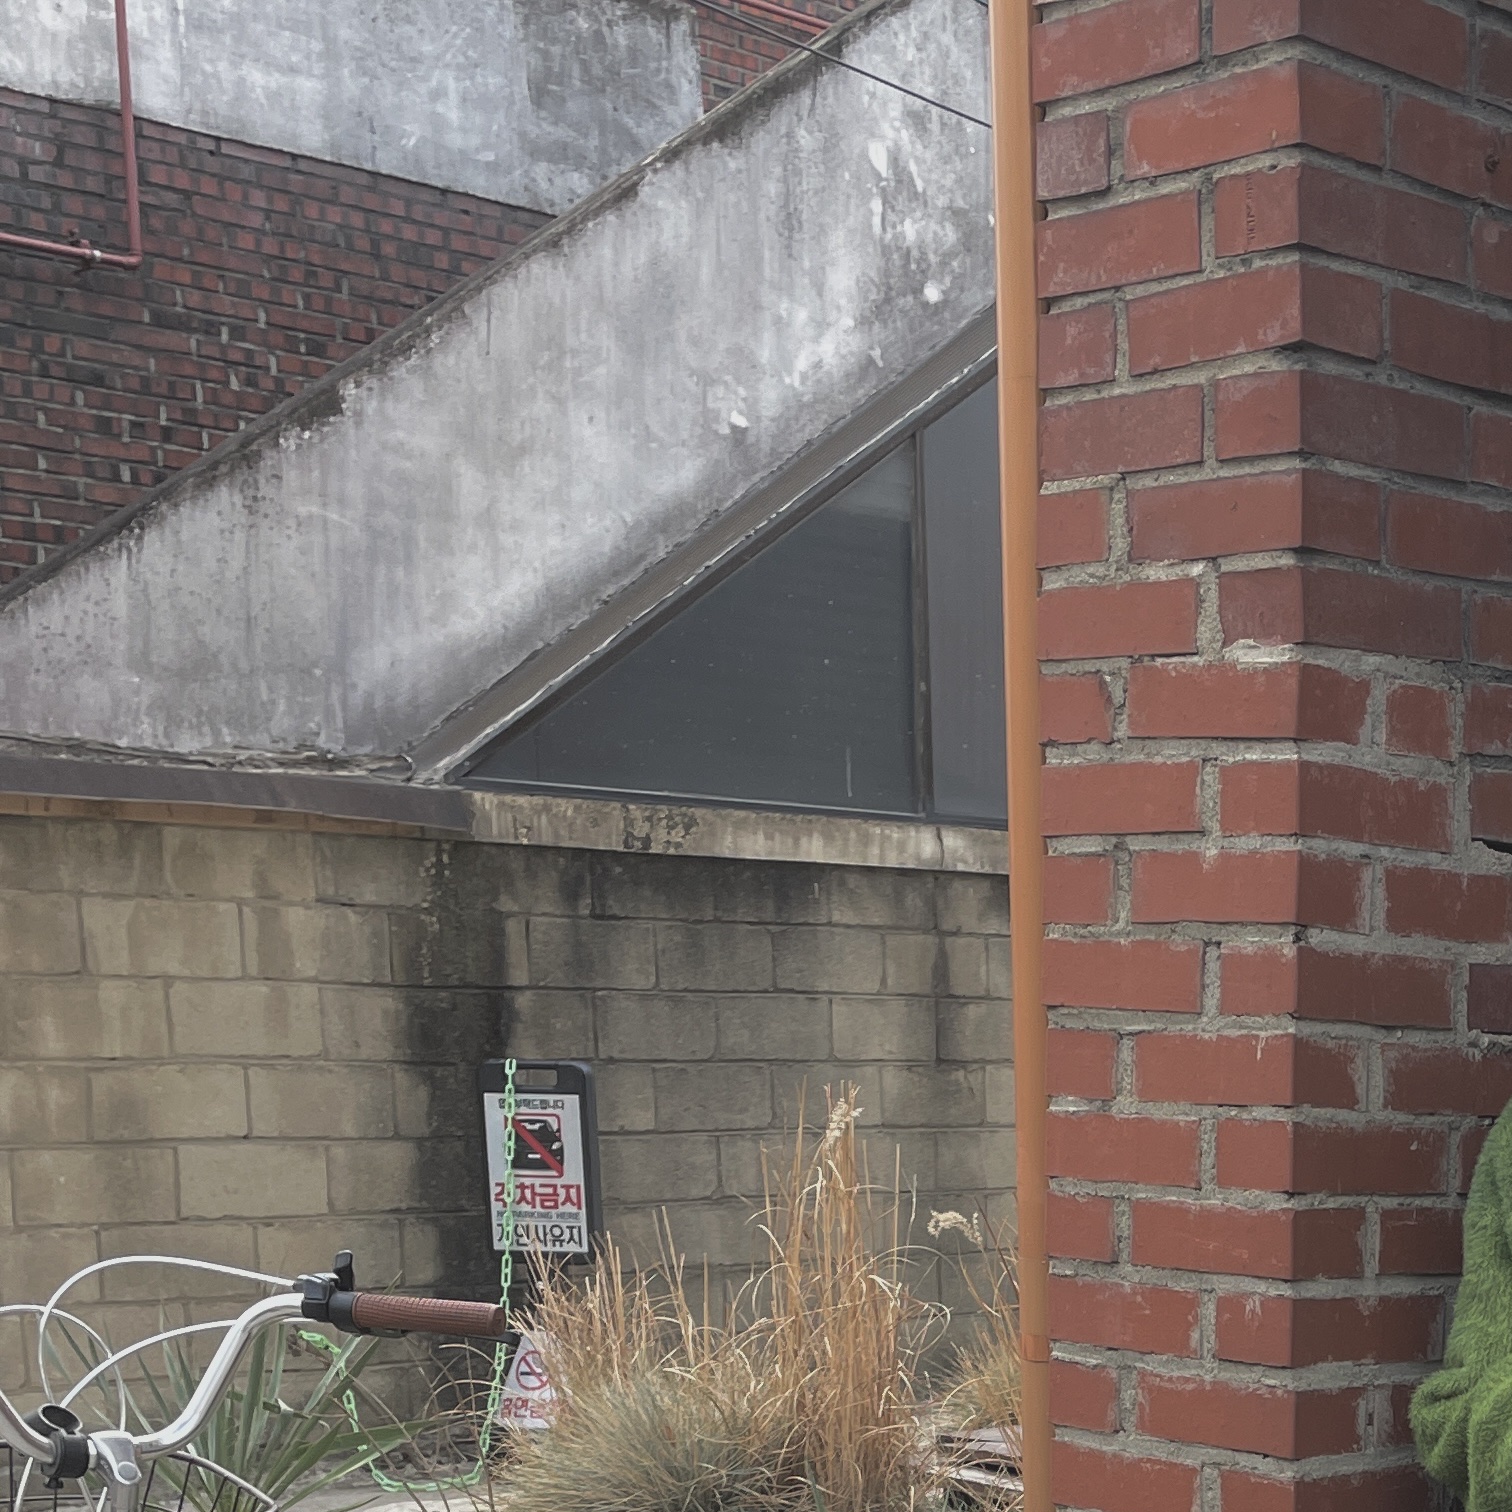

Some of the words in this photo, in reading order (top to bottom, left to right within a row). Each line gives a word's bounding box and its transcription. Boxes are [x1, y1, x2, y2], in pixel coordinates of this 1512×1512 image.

[494, 1182, 582, 1210] 주차금지
[556, 1211, 580, 1220] HERE
[501, 1397, 567, 1419] 흡연금
